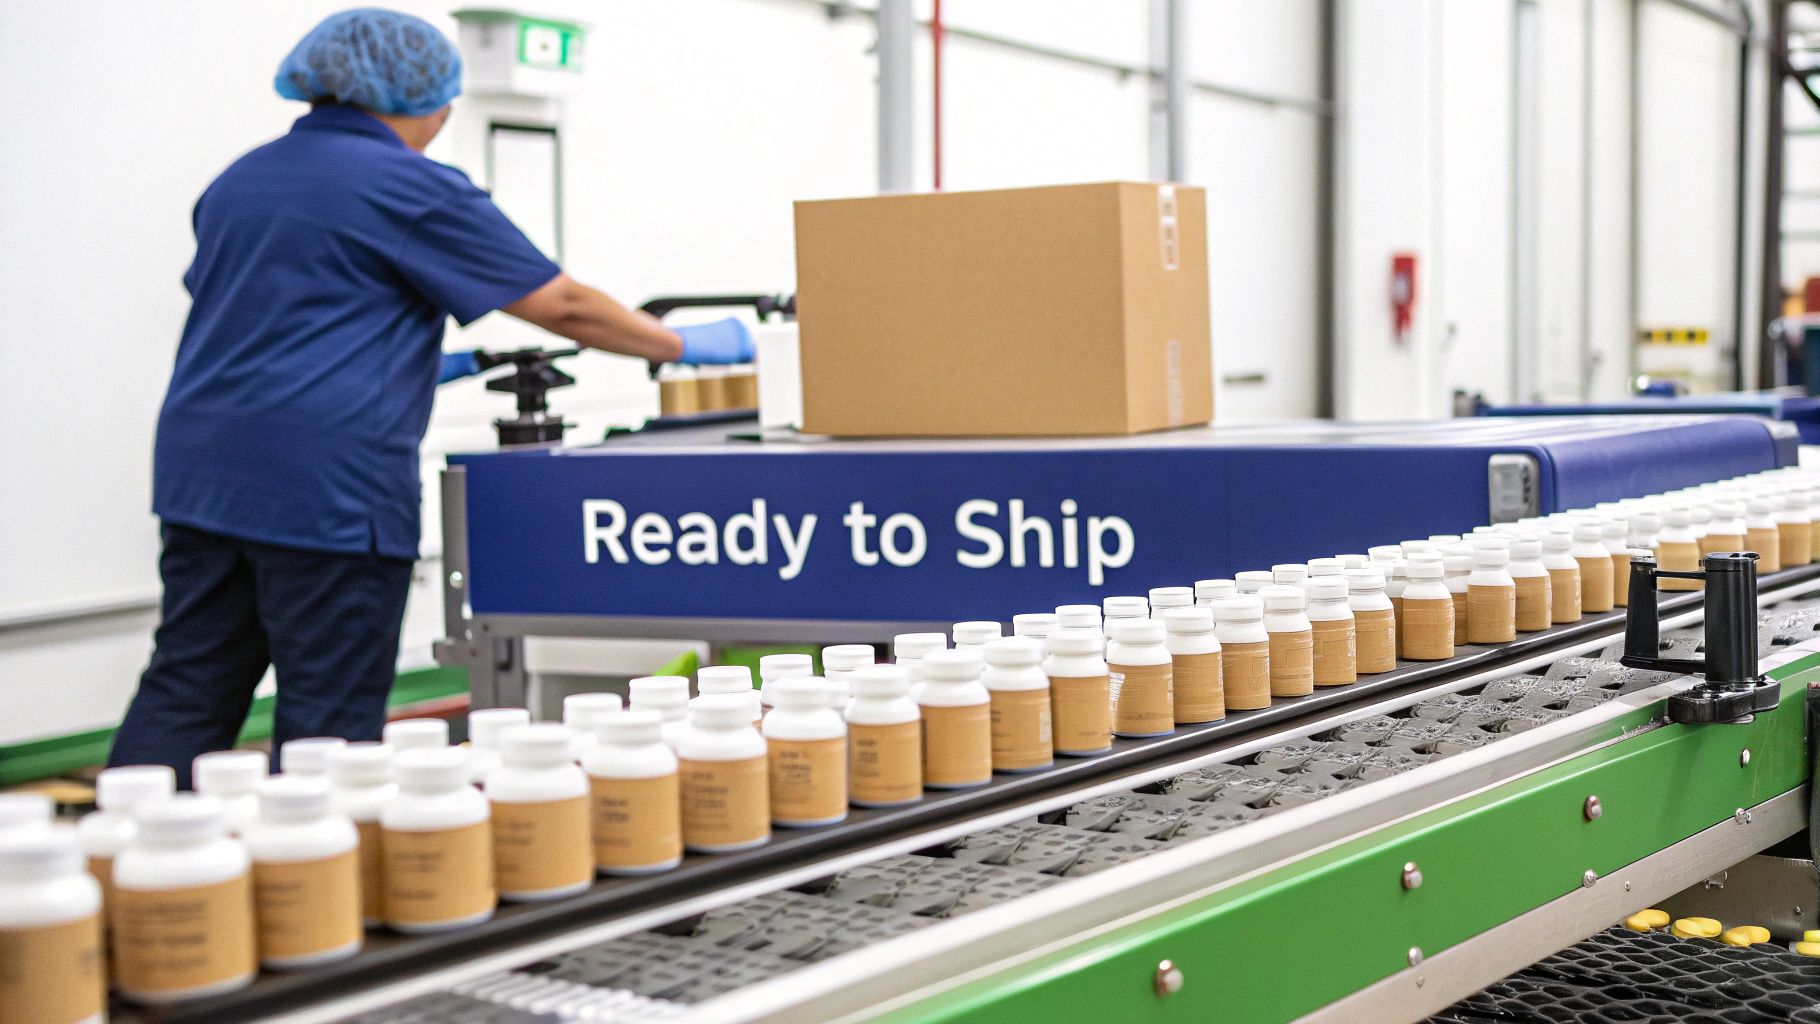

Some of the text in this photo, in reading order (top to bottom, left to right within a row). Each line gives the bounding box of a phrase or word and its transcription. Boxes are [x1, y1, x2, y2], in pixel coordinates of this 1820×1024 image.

[582, 498, 1135, 586] Ready to Ship
